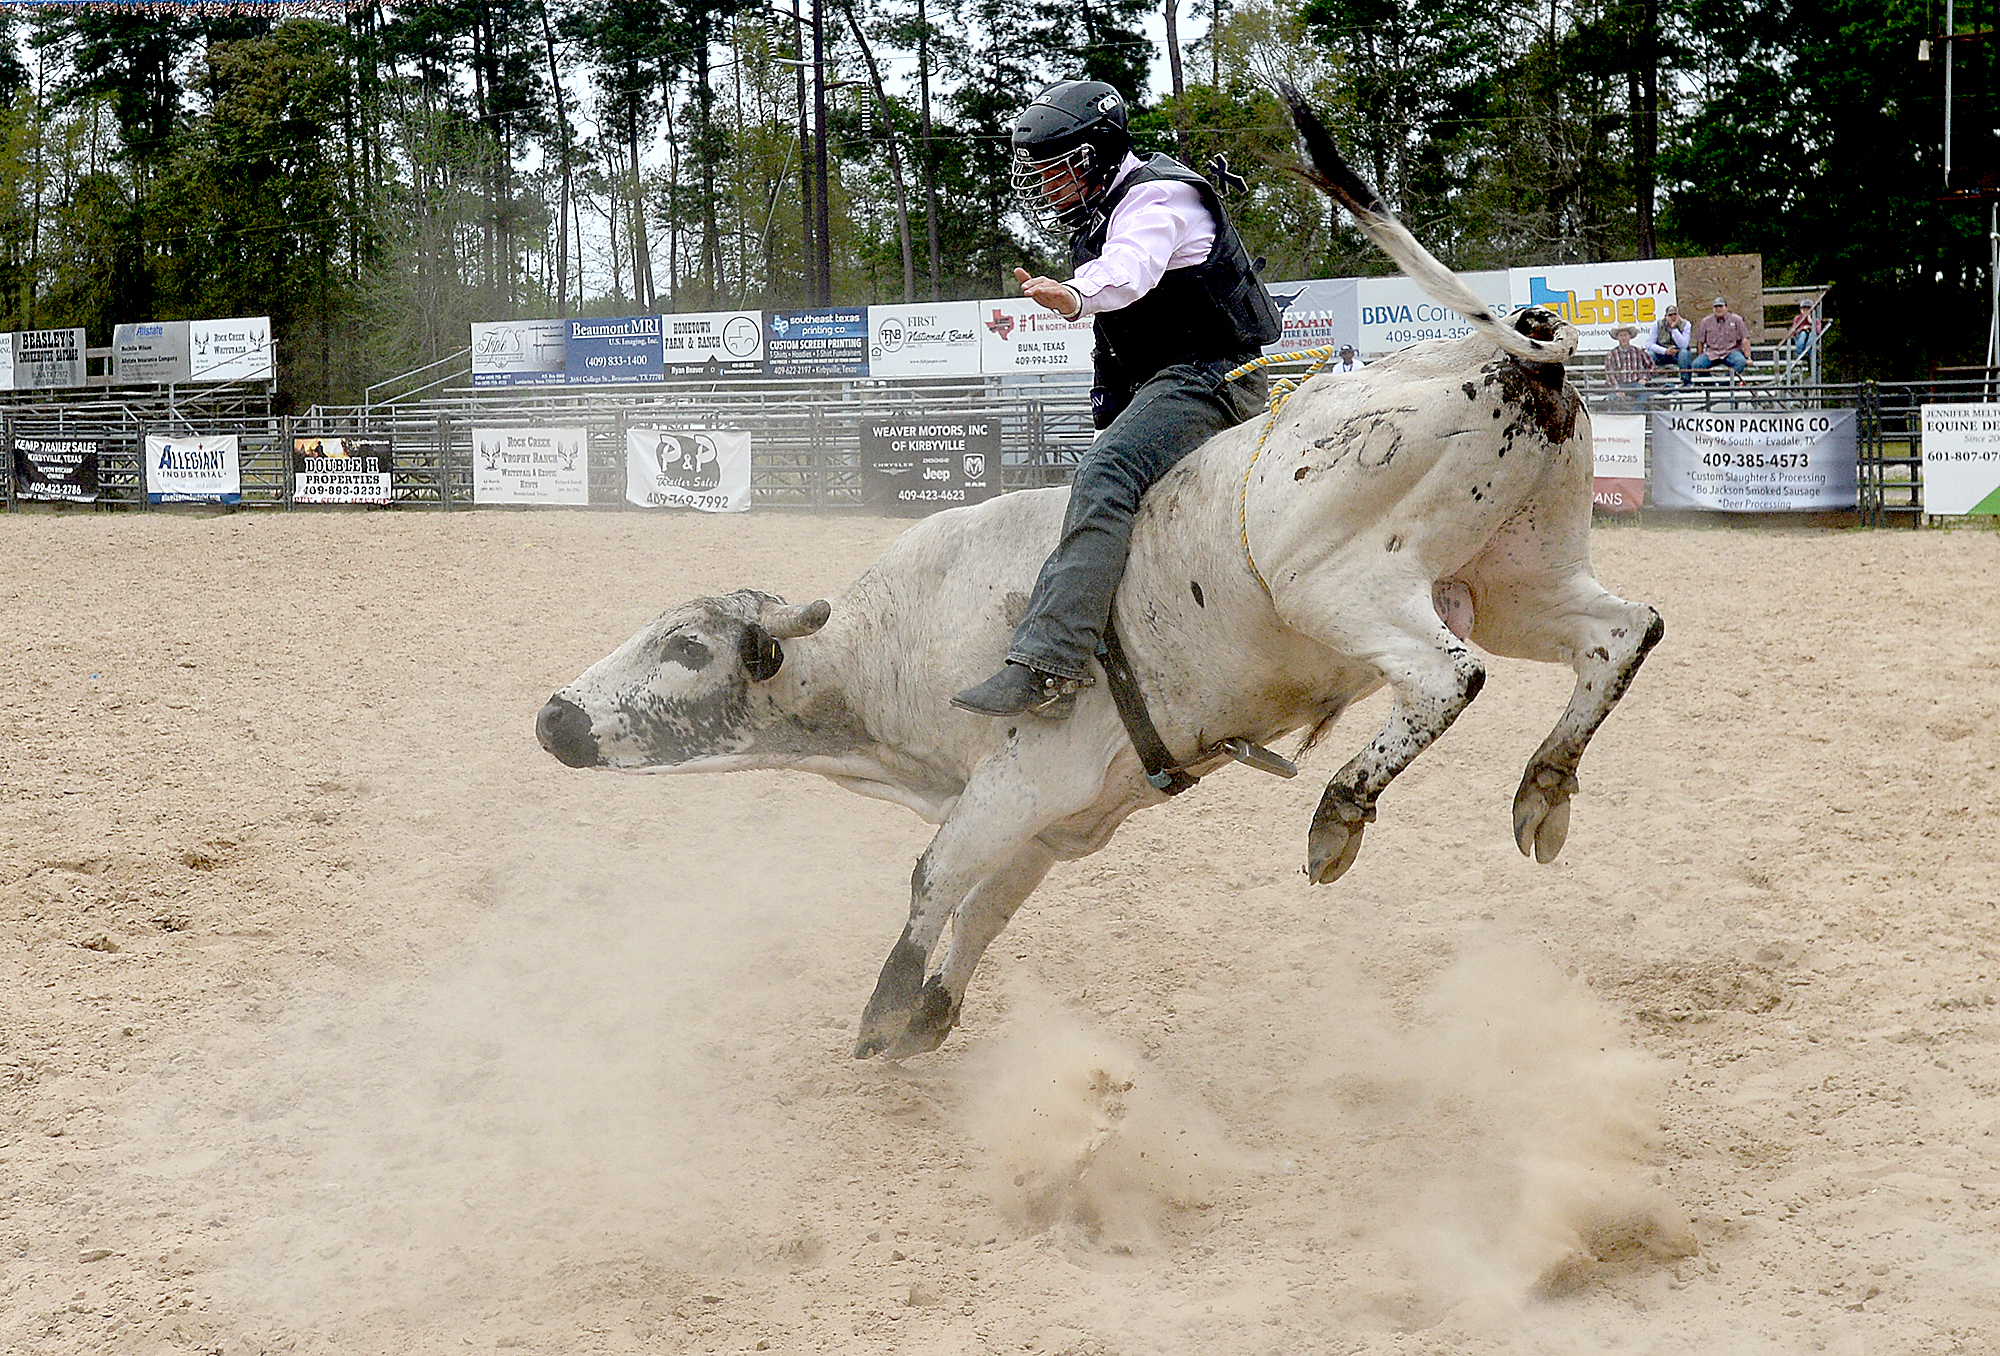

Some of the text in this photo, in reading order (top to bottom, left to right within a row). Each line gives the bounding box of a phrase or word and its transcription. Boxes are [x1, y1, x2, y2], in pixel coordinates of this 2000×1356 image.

[1603, 282, 1669, 297] TOYOTA
[789, 313, 860, 325] southeast texas
[907, 315, 937, 327] FIRST
[1282, 310, 1334, 329] EXAN
[1362, 305, 1414, 325] BBVA
[571, 318, 659, 336] Beaumont MRI
[673, 321, 711, 334] HOMETOWN
[1019, 313, 1036, 332] #1
[1046, 323, 1067, 331] NORTH
[802, 325, 833, 336] printing
[906, 329, 976, 342] National Bank
[1283, 328, 1332, 338] TIRE & LUBE
[22, 330, 75, 349] BEASLEY'S
[665, 336, 721, 350] FARM & RANCH
[769, 337, 862, 351] CUSTOM SCREEN PRINTING
[1017, 341, 1066, 353] BUNA, TEXAS
[584, 354, 648, 368] (409) 833-1400
[1015, 354, 1069, 365] 409-994-3522
[671, 366, 685, 376] Ryan
[1926, 409, 1971, 418] JENNIFER
[872, 424, 988, 437] WEAVER MOTORS, INC
[1668, 417, 1835, 433] JACKSON PACKING CO.
[1926, 420, 1978, 433] EQUINE
[14, 439, 97, 453] KEMP TRAILER SALES
[507, 436, 551, 448] ROCK CREEK
[891, 440, 966, 452] OF KIRBYVILLE
[1695, 435, 1816, 448] Hwy 96 South Evadale, TX
[63, 454, 83, 464] TEXAS
[158, 444, 226, 470] ALLEGIANT
[501, 452, 558, 464] TROPHY RANCH
[1702, 452, 1810, 468] 409-385-4573
[305, 457, 379, 473] DOUBLE H
[305, 475, 380, 484] PROPERTIES
[922, 467, 951, 482] Jeep
[1725, 472, 1768, 485] Slaughter
[1769, 472, 1777, 482] &
[1778, 472, 1827, 485] Processing
[30, 482, 82, 495] 409-423-2786
[693, 476, 718, 488] Sales
[898, 489, 966, 501] 409-423-4623
[1709, 485, 1744, 496] Jackson
[1745, 485, 1782, 497] Smoked
[1783, 486, 1822, 498] Sausage
[1745, 499, 1792, 510] Processing
